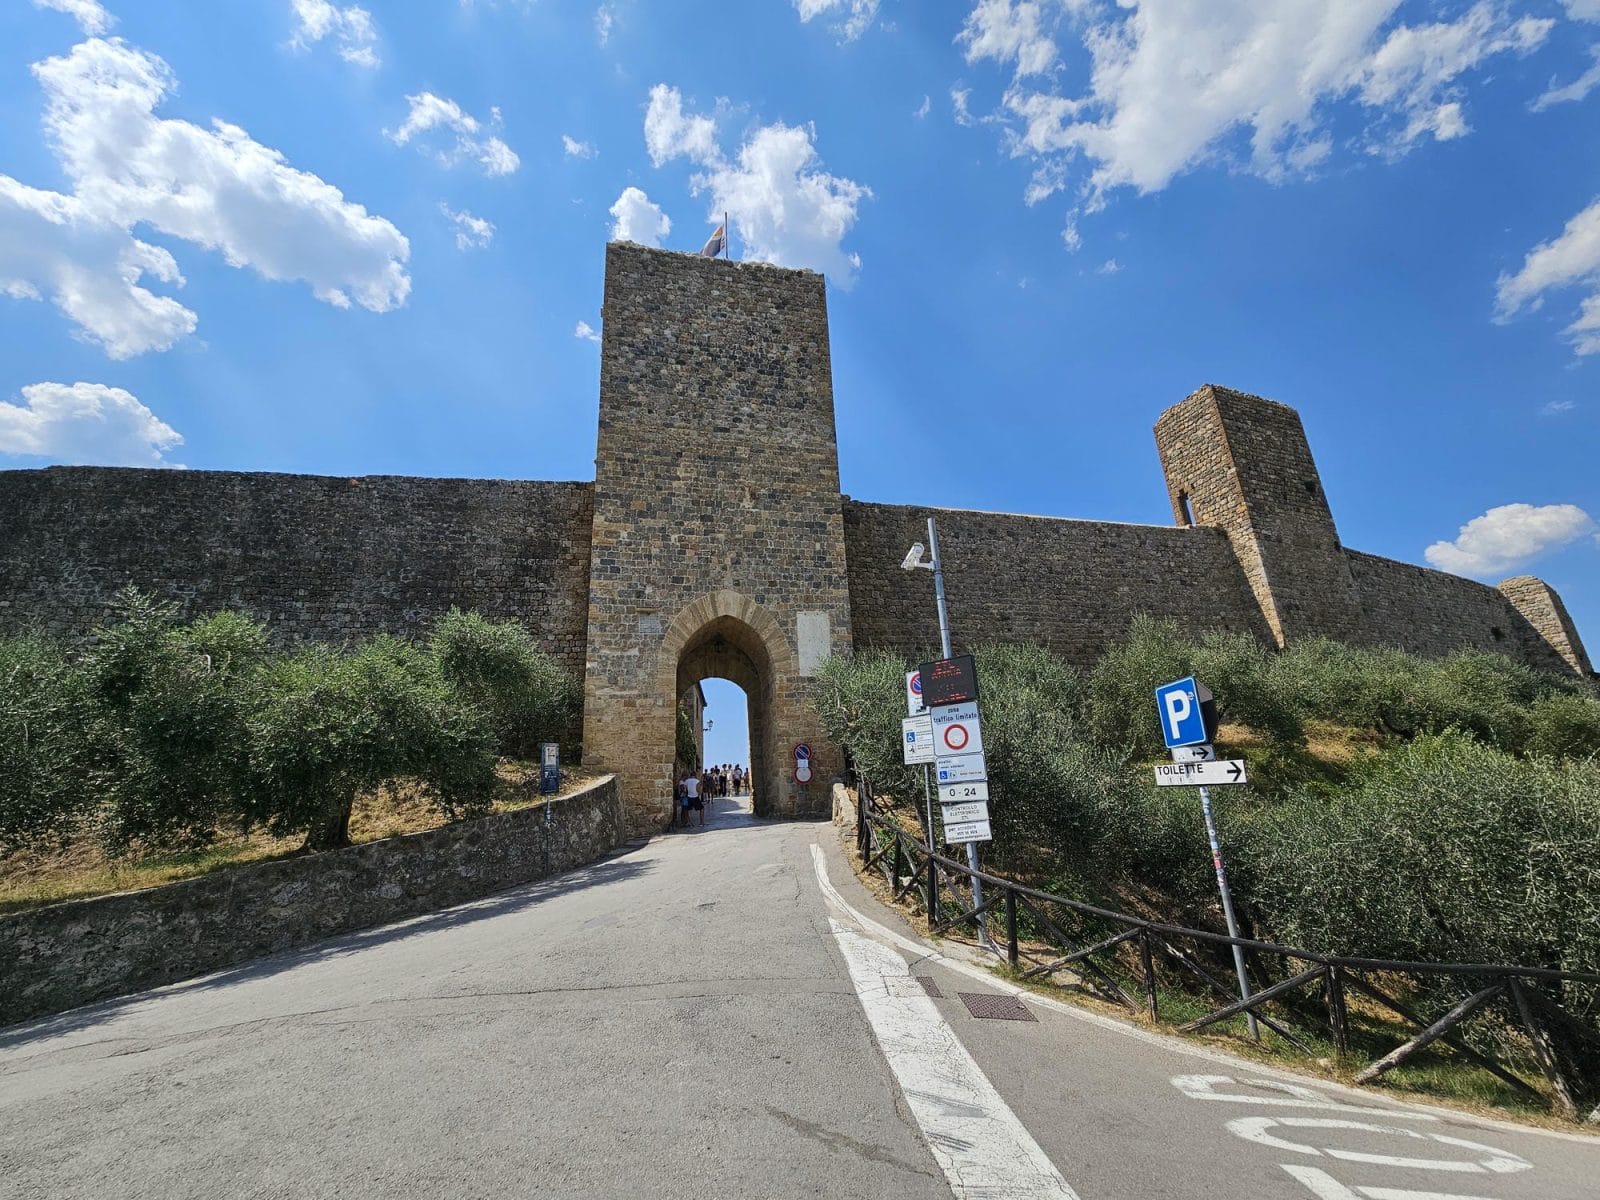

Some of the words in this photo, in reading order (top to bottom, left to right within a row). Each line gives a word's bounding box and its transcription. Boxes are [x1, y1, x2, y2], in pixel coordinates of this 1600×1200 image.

[956, 712, 977, 720] limitato
[1165, 690, 1190, 740] P
[1157, 763, 1204, 776] TOILETTE
[964, 788, 976, 796] 24
